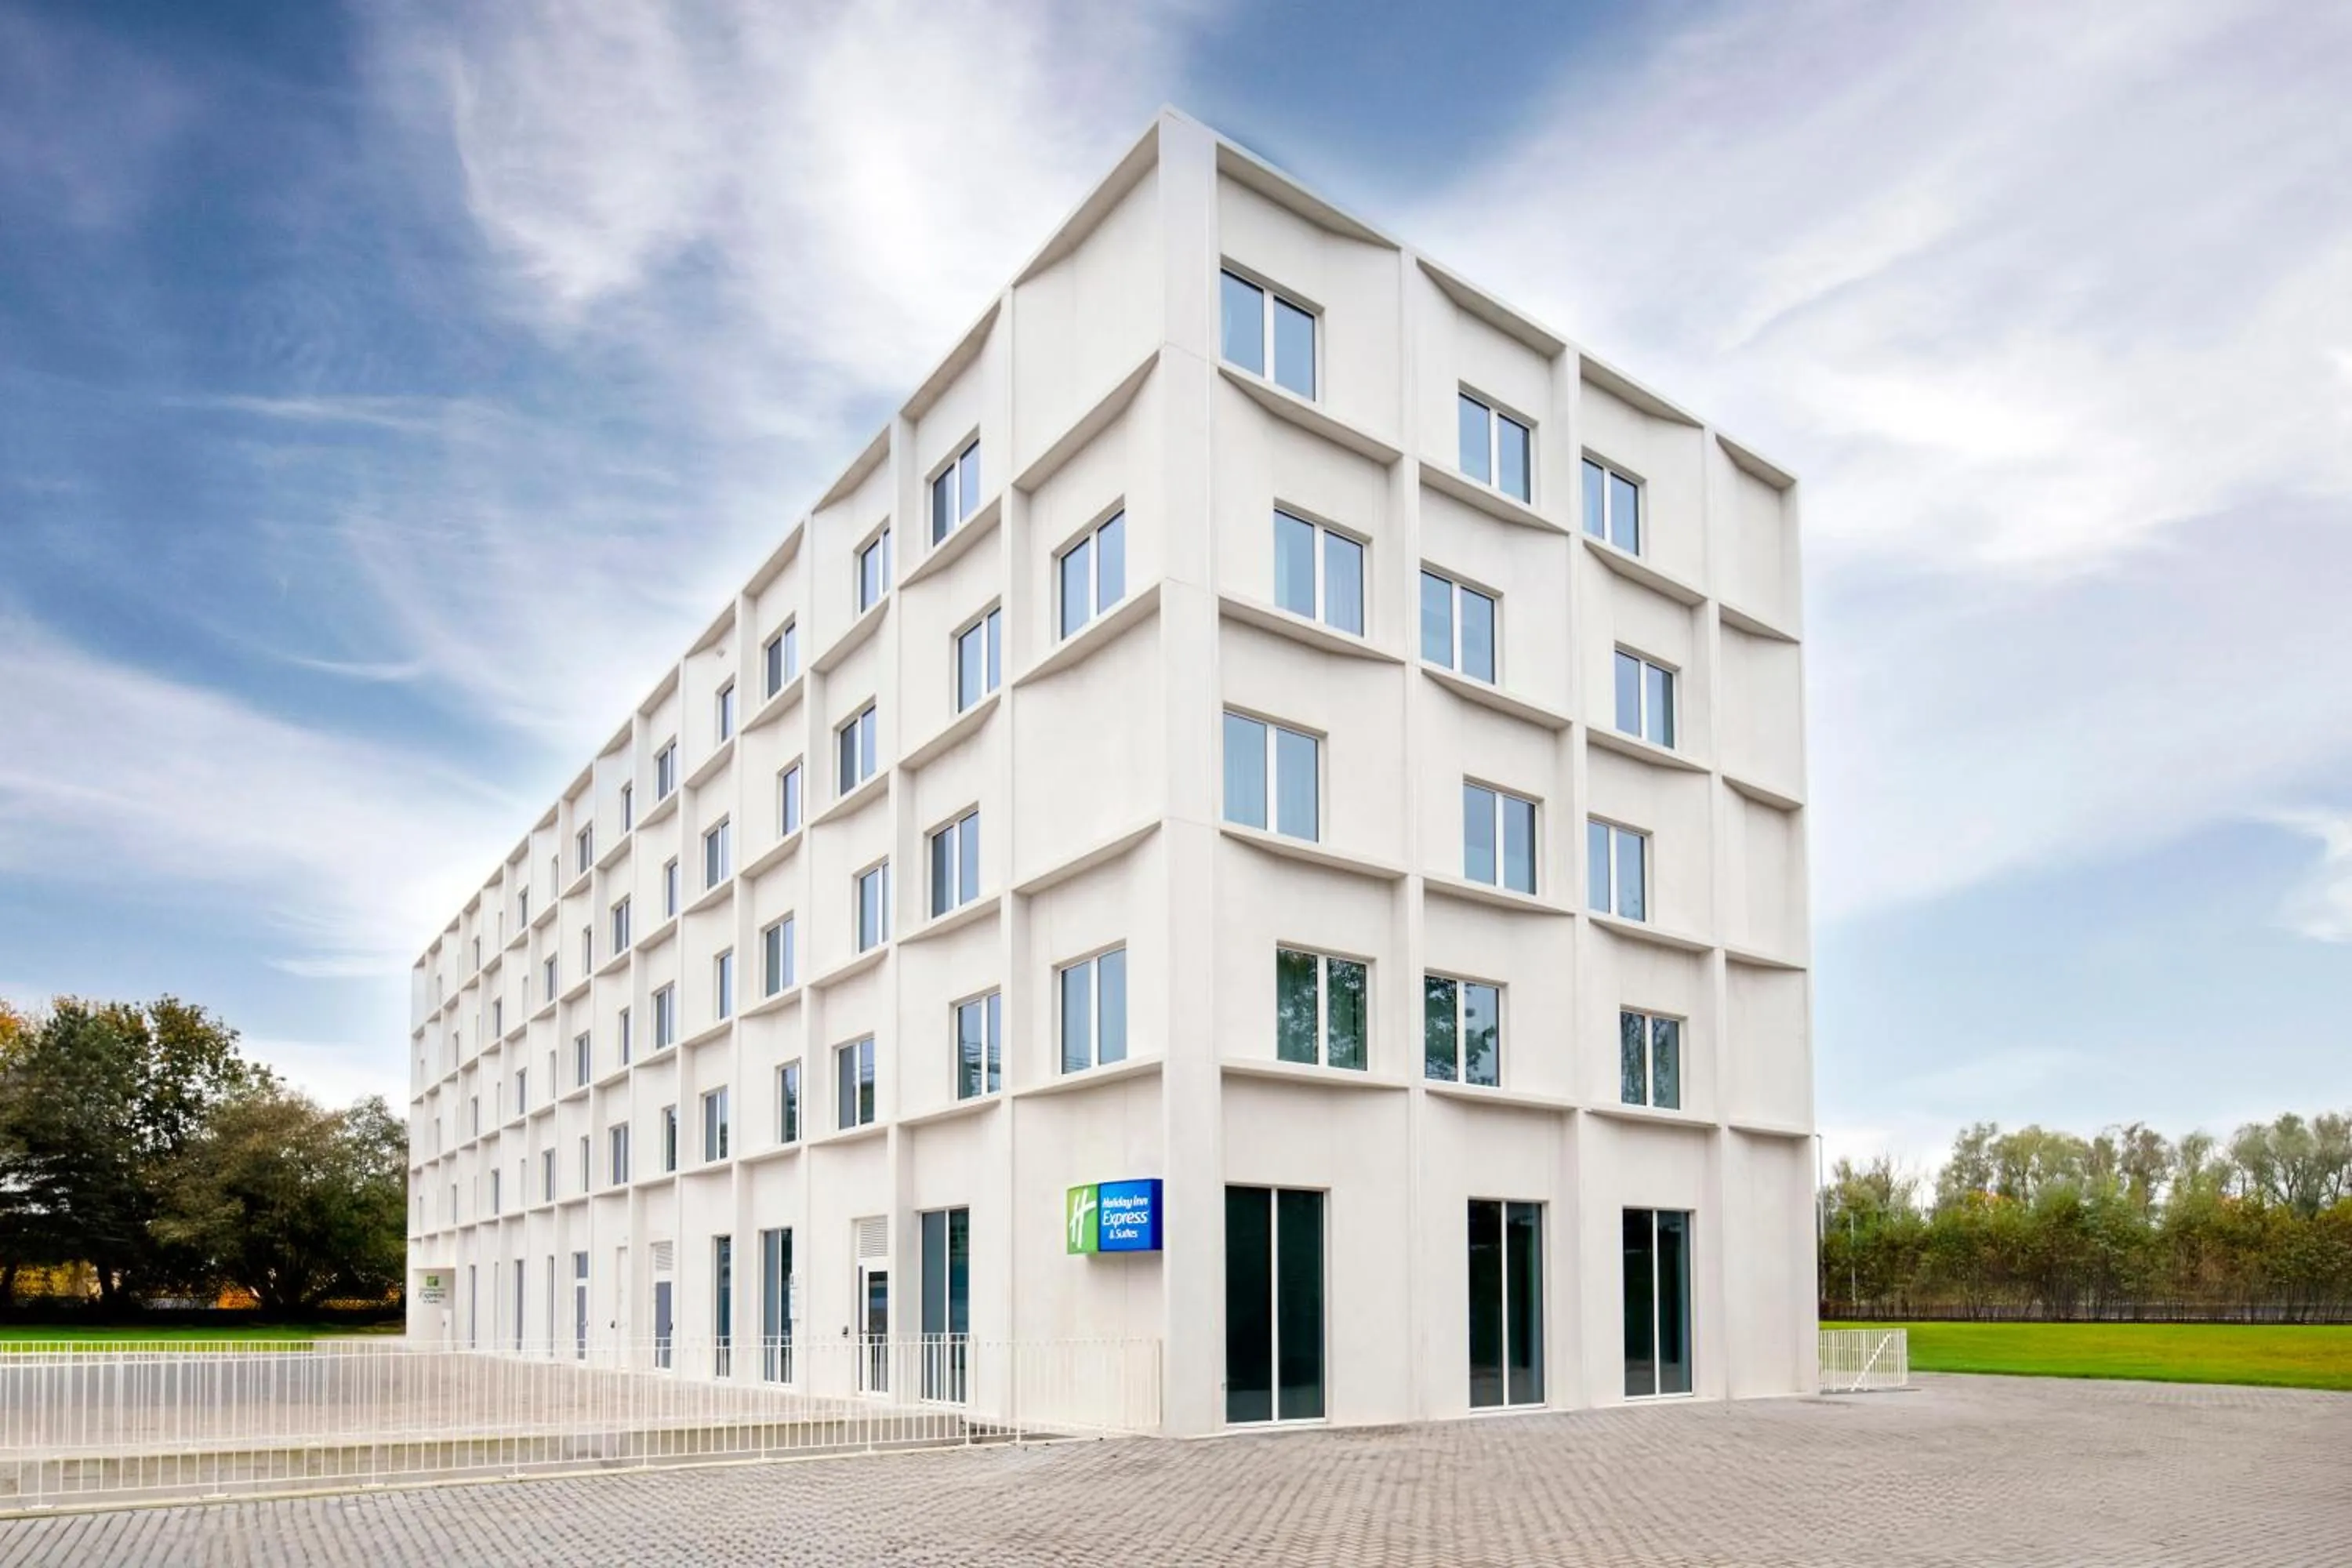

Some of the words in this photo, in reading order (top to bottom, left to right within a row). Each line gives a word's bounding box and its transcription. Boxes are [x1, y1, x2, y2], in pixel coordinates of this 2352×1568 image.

[1102, 1196, 1132, 1209] Holiday
[1133, 1195, 1149, 1206] Inn
[1102, 1210, 1148, 1229] Express
[1116, 1229, 1138, 1239] Suites
